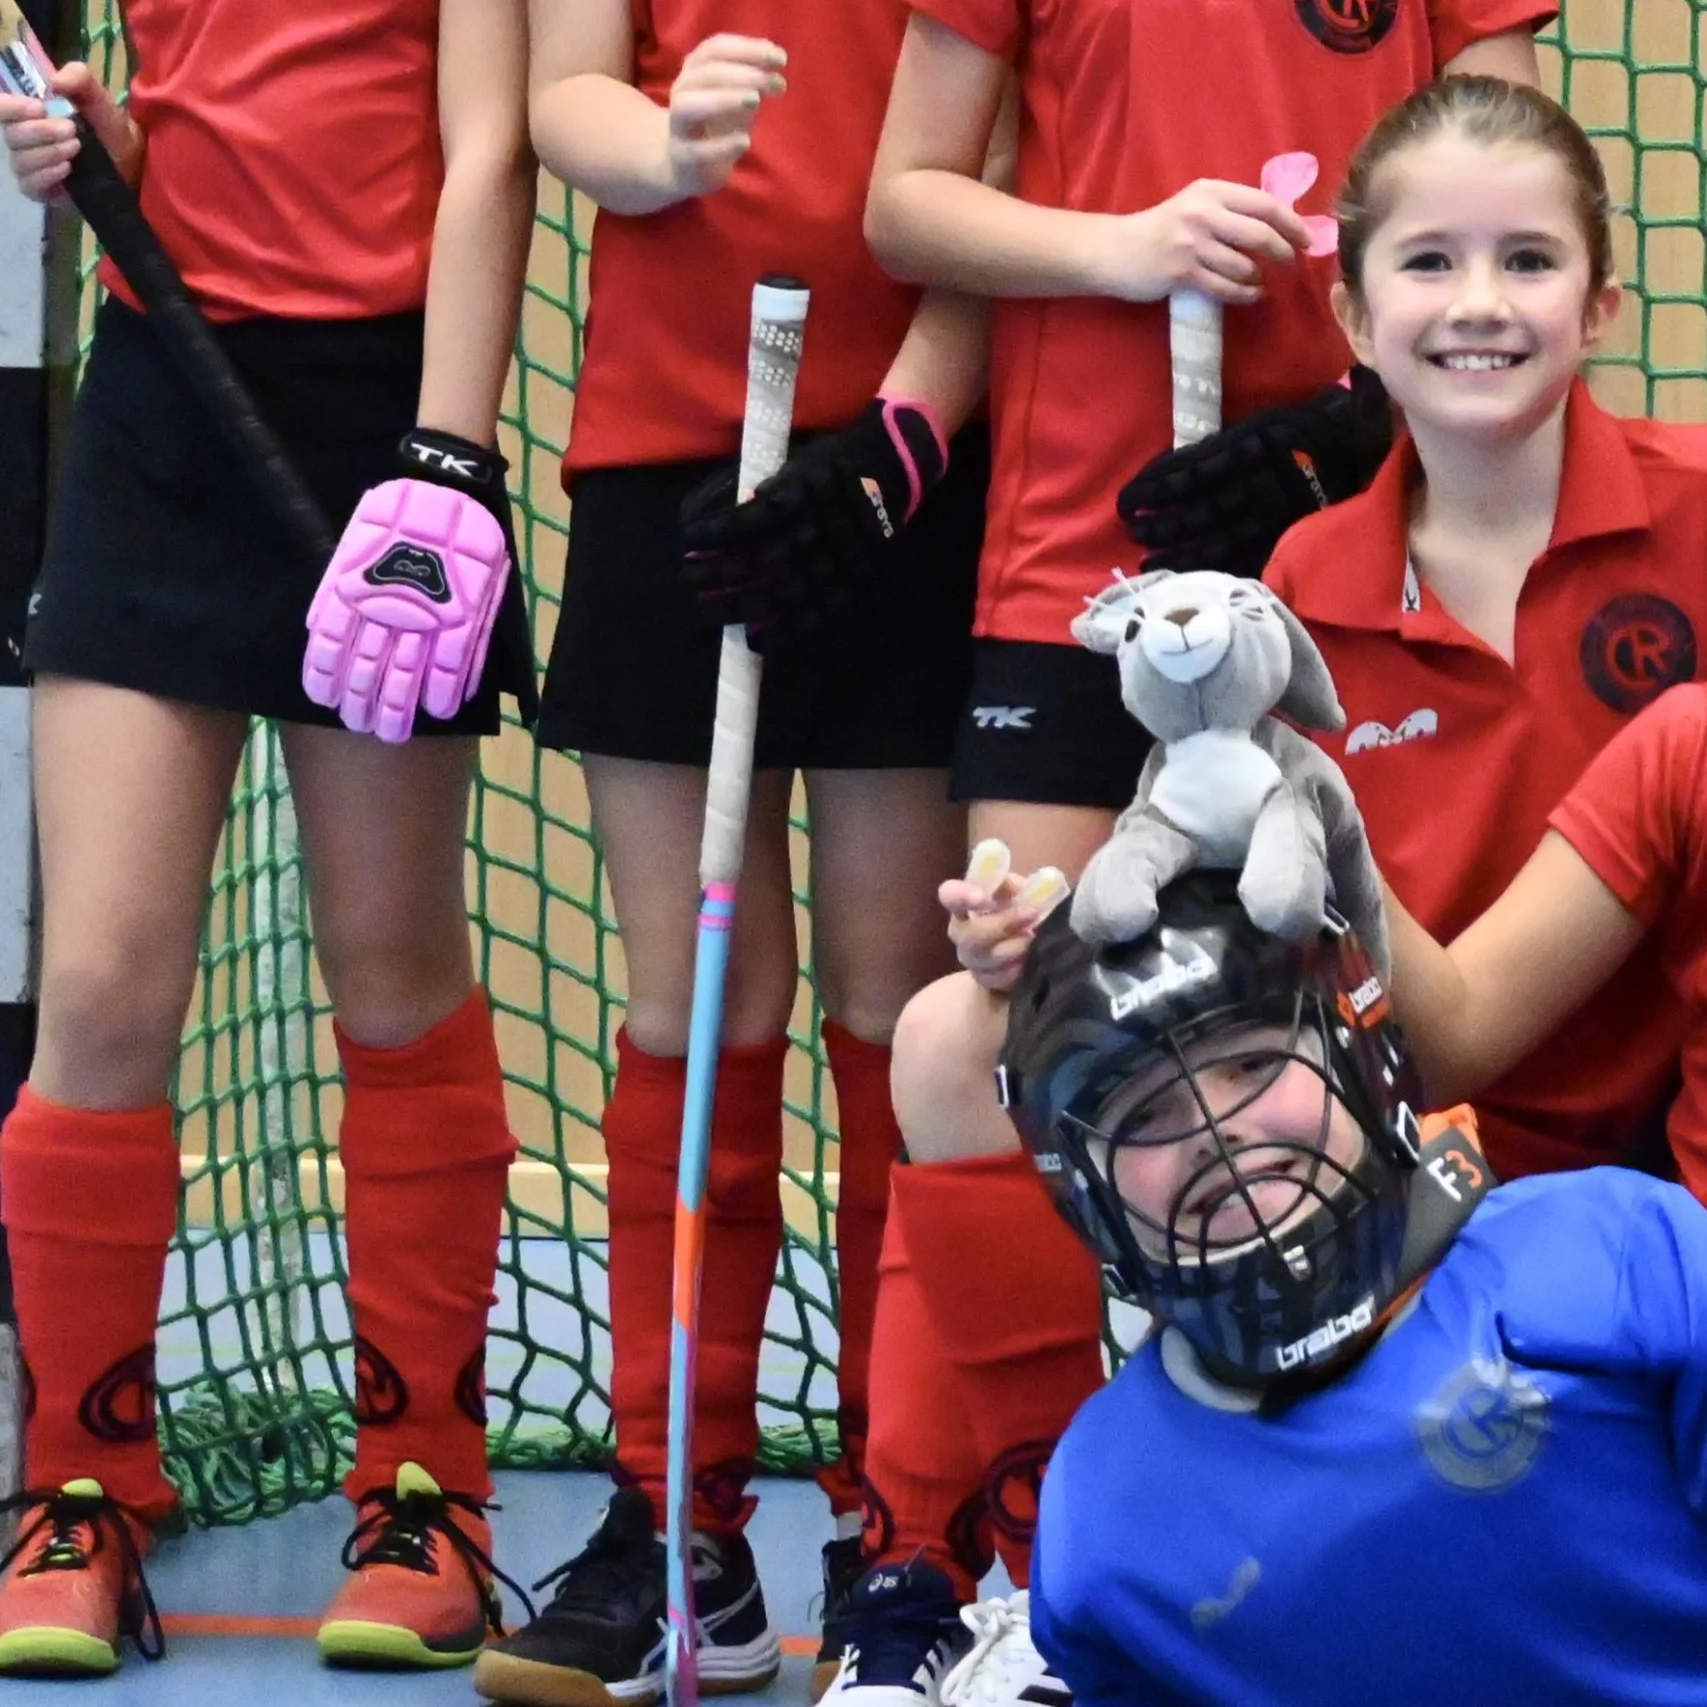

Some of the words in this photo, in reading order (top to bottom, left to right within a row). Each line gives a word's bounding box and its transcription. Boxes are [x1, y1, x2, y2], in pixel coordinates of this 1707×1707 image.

[410, 442, 479, 478] TK
[973, 706, 1037, 729] TK
[1427, 1150, 1483, 1203] F3
[1275, 1300, 1372, 1371] brabo
